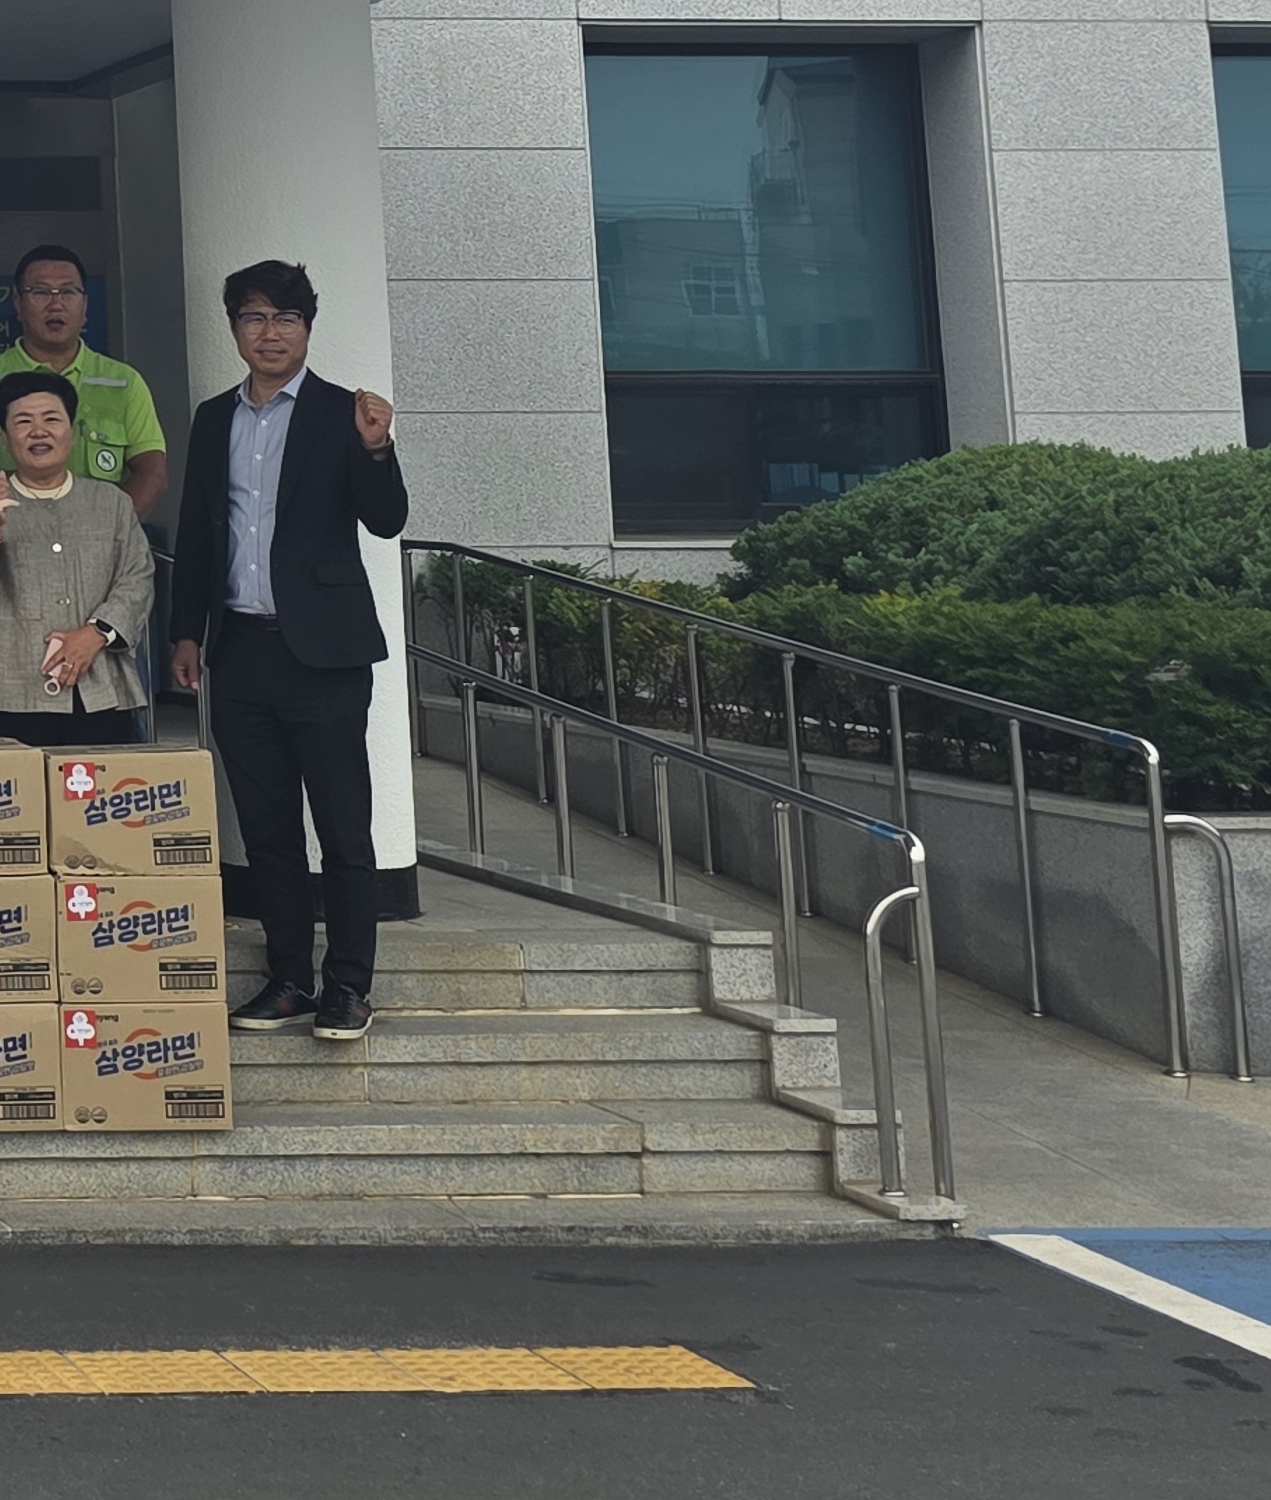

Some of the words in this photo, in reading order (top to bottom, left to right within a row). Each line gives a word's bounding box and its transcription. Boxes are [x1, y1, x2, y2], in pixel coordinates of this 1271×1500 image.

[84, 780, 183, 826] 삼양라면
[92, 904, 191, 949] 삼양라면
[95, 1032, 197, 1077] 삼양라면
